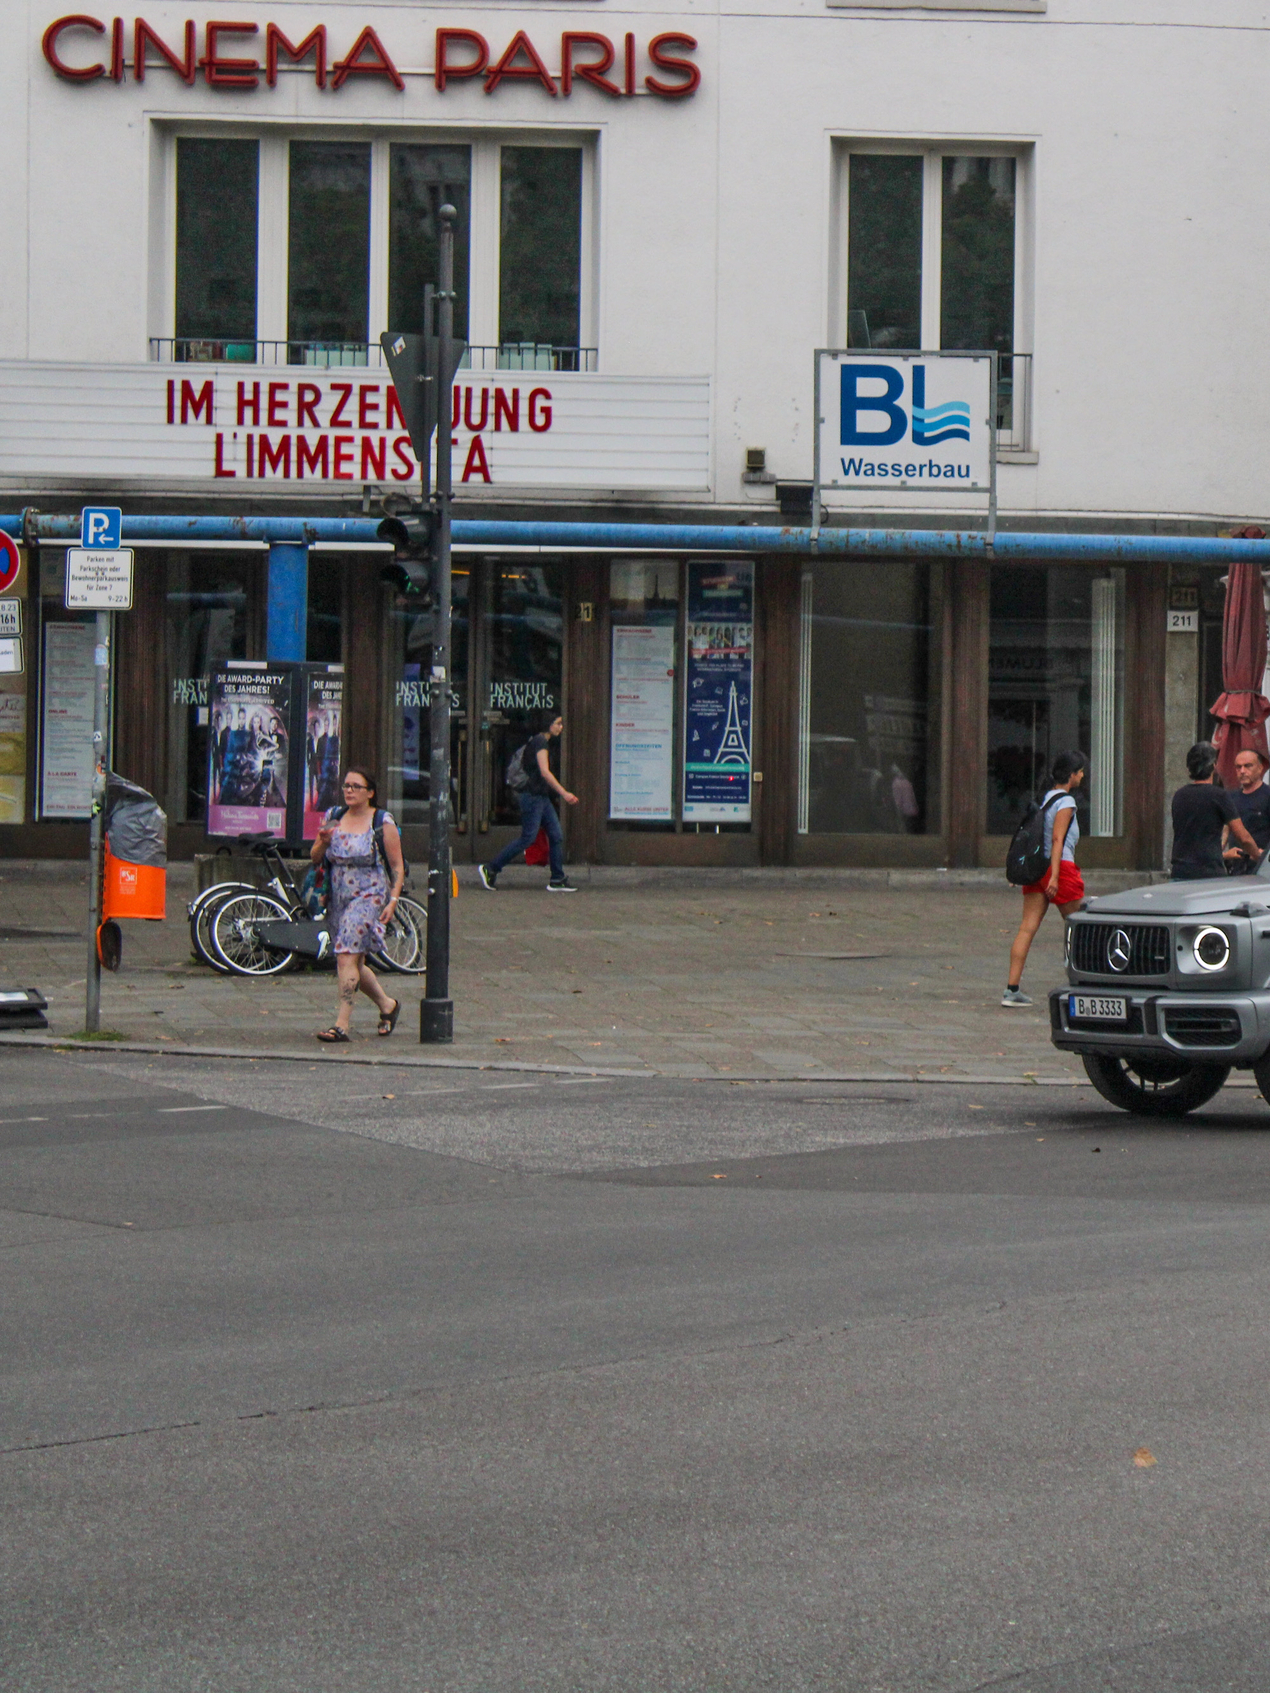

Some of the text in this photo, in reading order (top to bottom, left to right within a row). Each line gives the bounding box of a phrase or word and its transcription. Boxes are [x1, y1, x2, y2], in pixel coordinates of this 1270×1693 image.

[41, 14, 702, 97] CINEMA PARIS
[166, 378, 553, 433] IM HERZEN JUNG
[840, 363, 971, 447] BL
[213, 432, 493, 483] L'IMMENSA
[840, 457, 971, 478] Wasserbau
[86, 555, 105, 563] Parken
[71, 574, 129, 582] Bewohnerparkausweis
[1172, 615, 1191, 626] 211
[217, 674, 285, 685] DIE AWARD-PARTY
[224, 684, 271, 695] DES JAHRES!
[490, 682, 548, 697] INSTITUT
[1099, 1000, 1123, 1017] 3333
